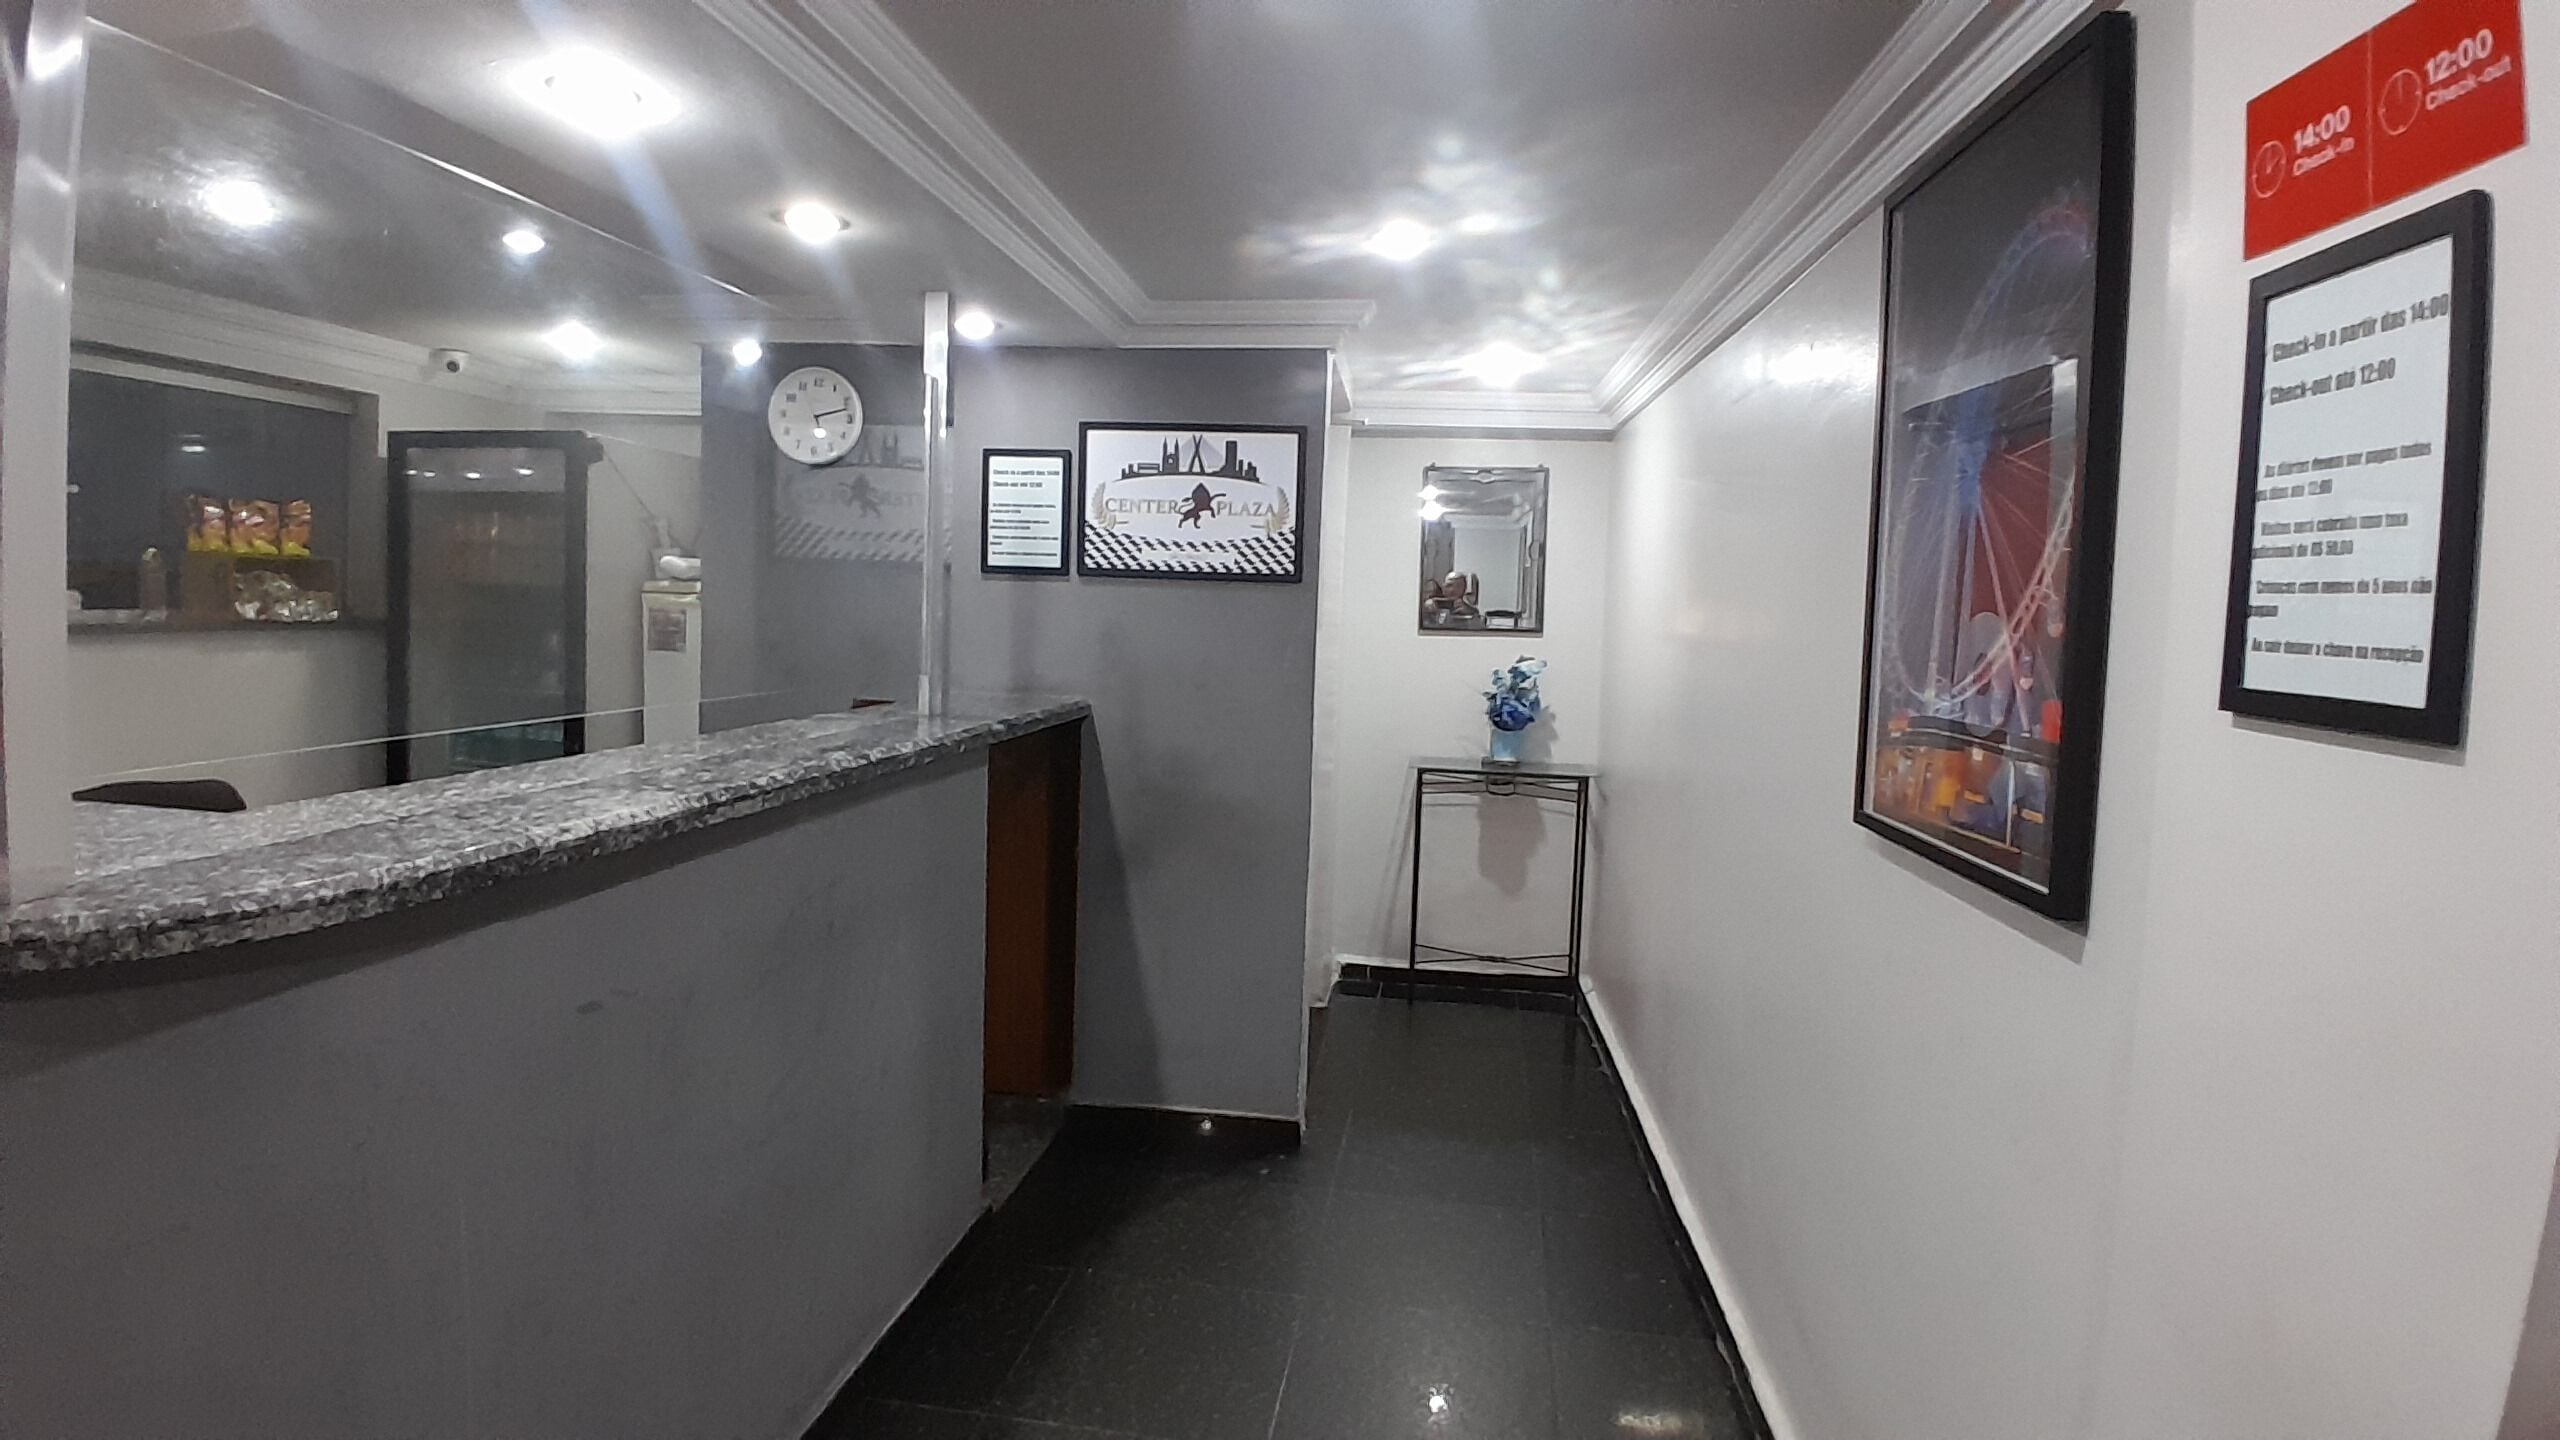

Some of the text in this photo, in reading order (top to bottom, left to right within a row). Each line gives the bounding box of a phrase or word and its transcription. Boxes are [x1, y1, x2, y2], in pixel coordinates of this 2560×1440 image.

[2424, 29, 2493, 84] 12:00
[2425, 56, 2511, 110] Check-out
[2294, 105, 2351, 153] 14:00
[2293, 137, 2355, 176] Check-in
[2273, 333, 2326, 362] Check-in
[2339, 317, 2378, 345] partir
[2381, 310, 2406, 332] das
[2411, 293, 2449, 323] 14:00
[2270, 375, 2332, 405] Check-out
[2361, 358, 2396, 385] 12:00
[1105, 498, 1276, 517] CENTER PLAZA
